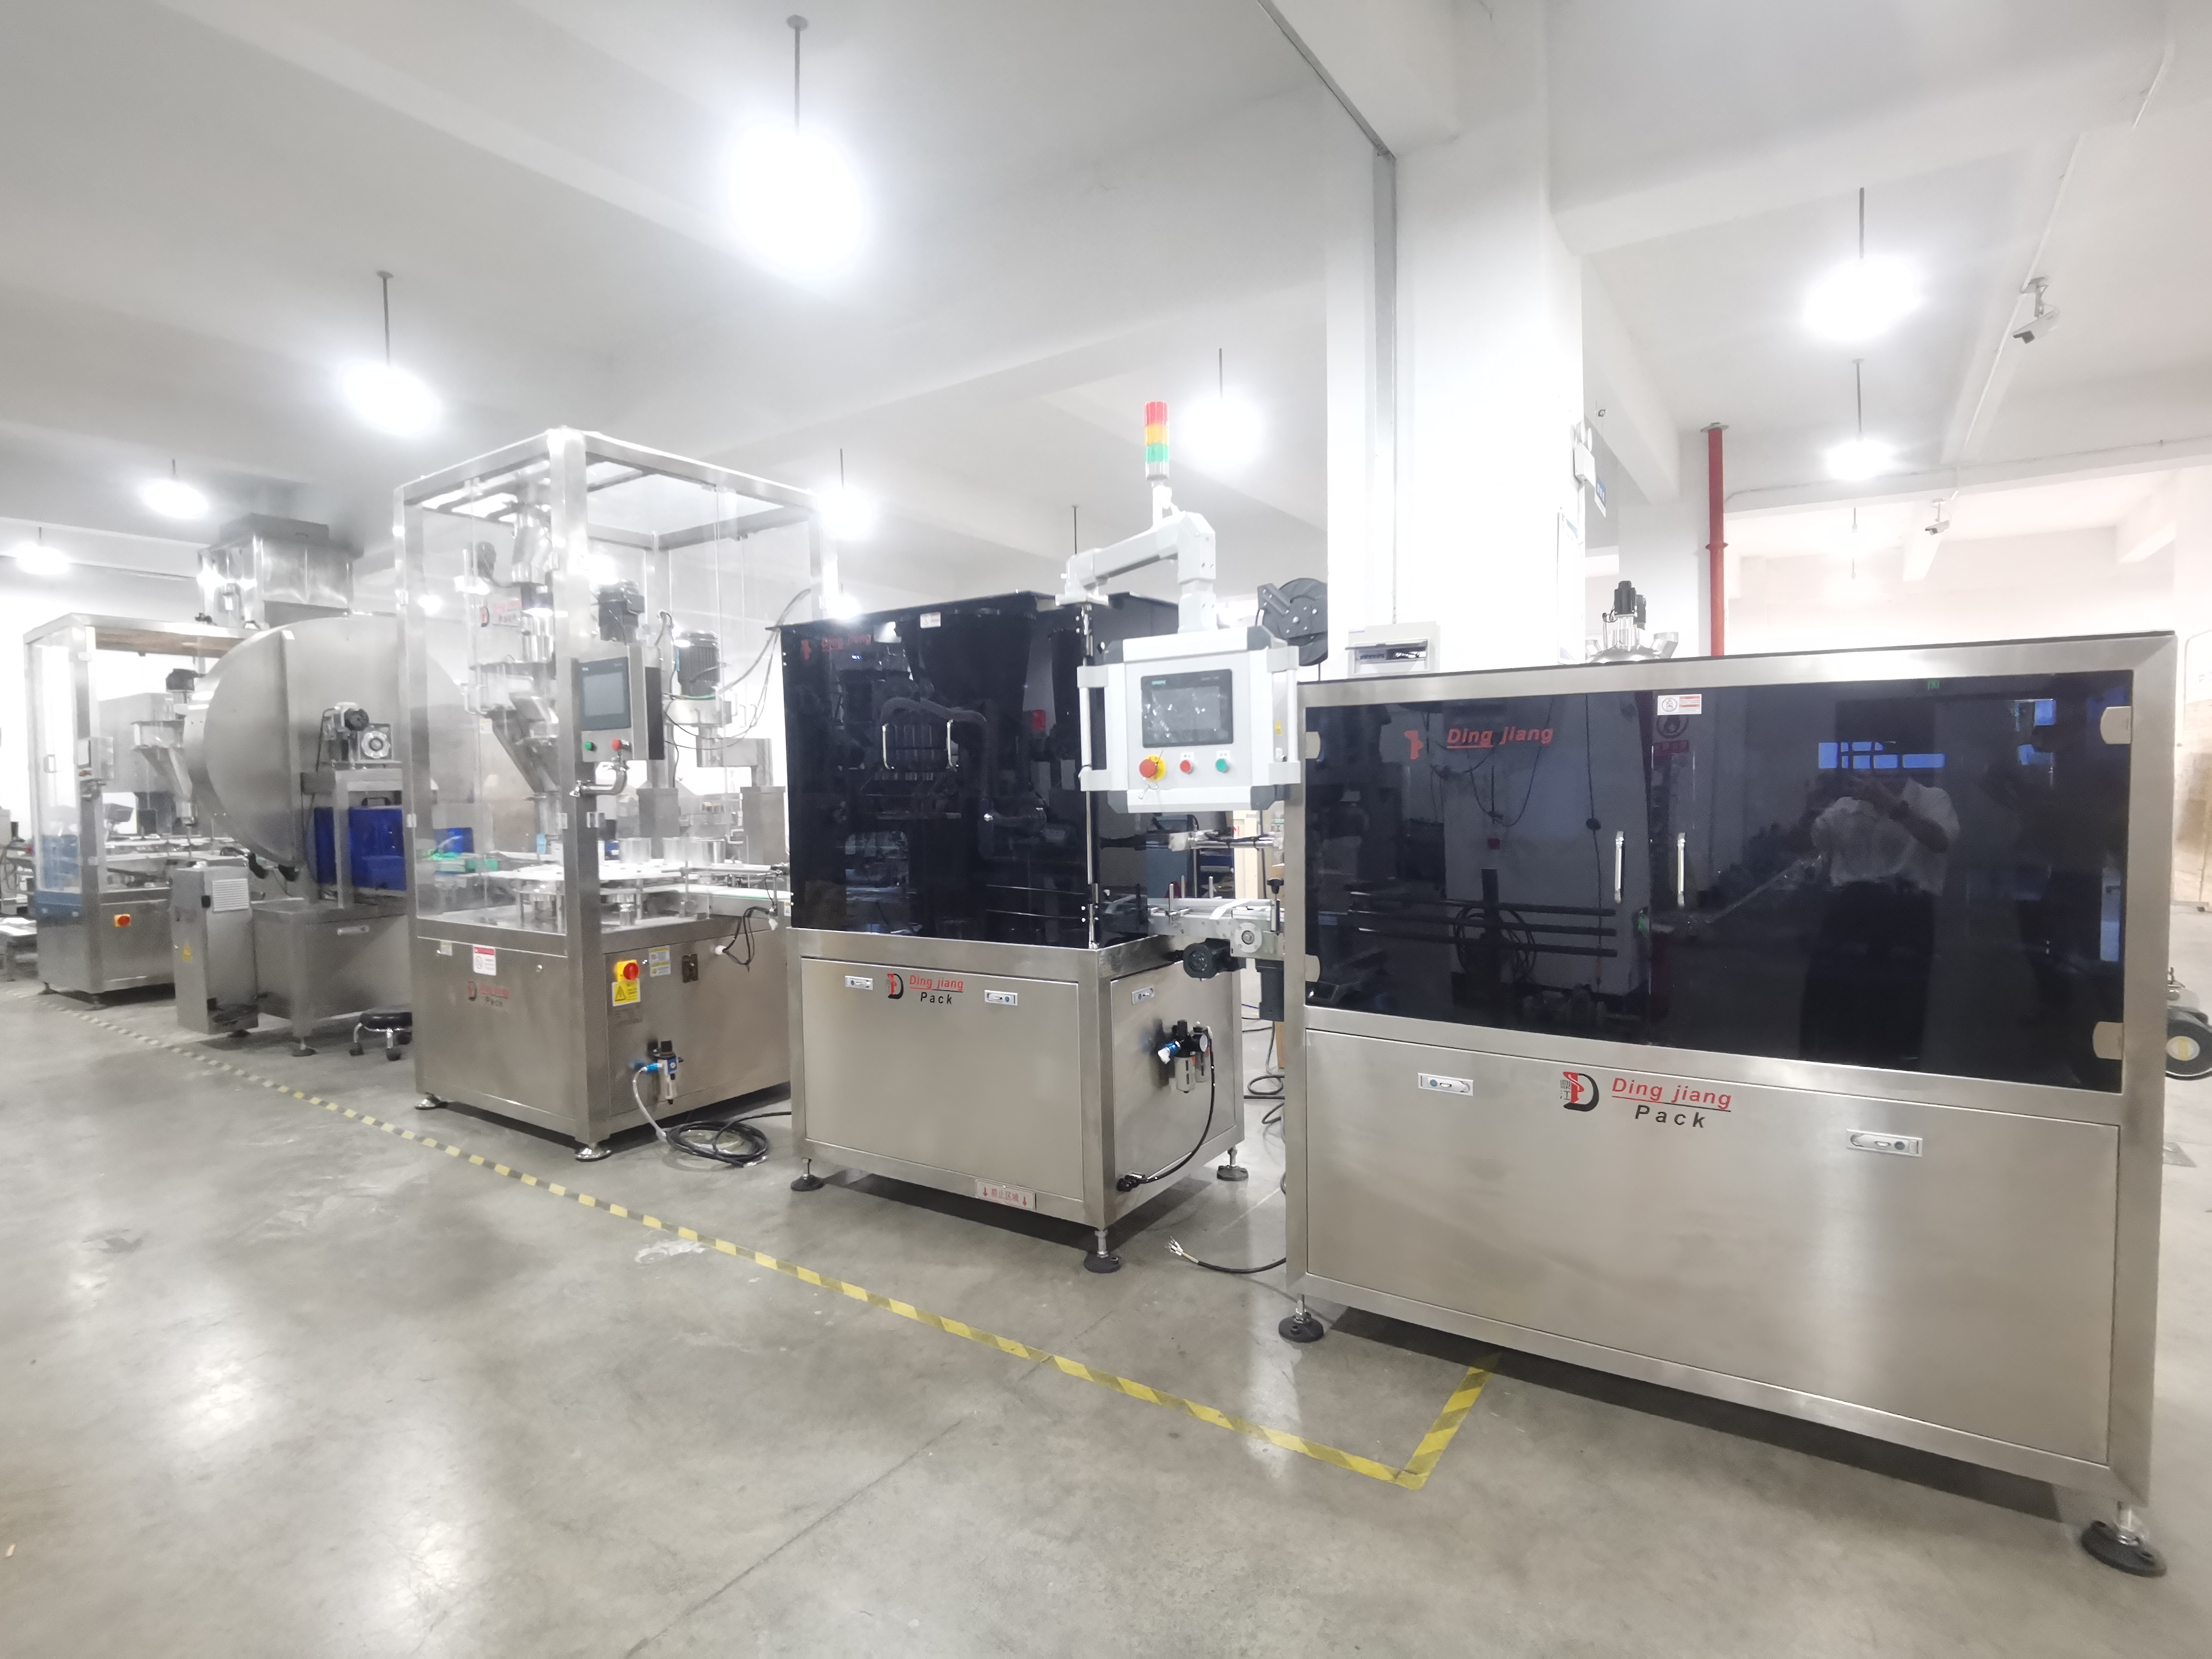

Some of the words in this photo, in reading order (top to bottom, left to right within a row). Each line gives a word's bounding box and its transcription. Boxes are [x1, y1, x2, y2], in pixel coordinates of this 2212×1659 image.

[1445, 728, 1493, 746] Ding
[909, 975, 933, 988] Ding
[937, 976, 964, 991] jiang
[920, 991, 952, 1005] Pack
[1612, 1077, 1663, 1101] Ding
[1671, 1084, 1732, 1110] jiang
[1635, 1104, 1706, 1128] Pack
